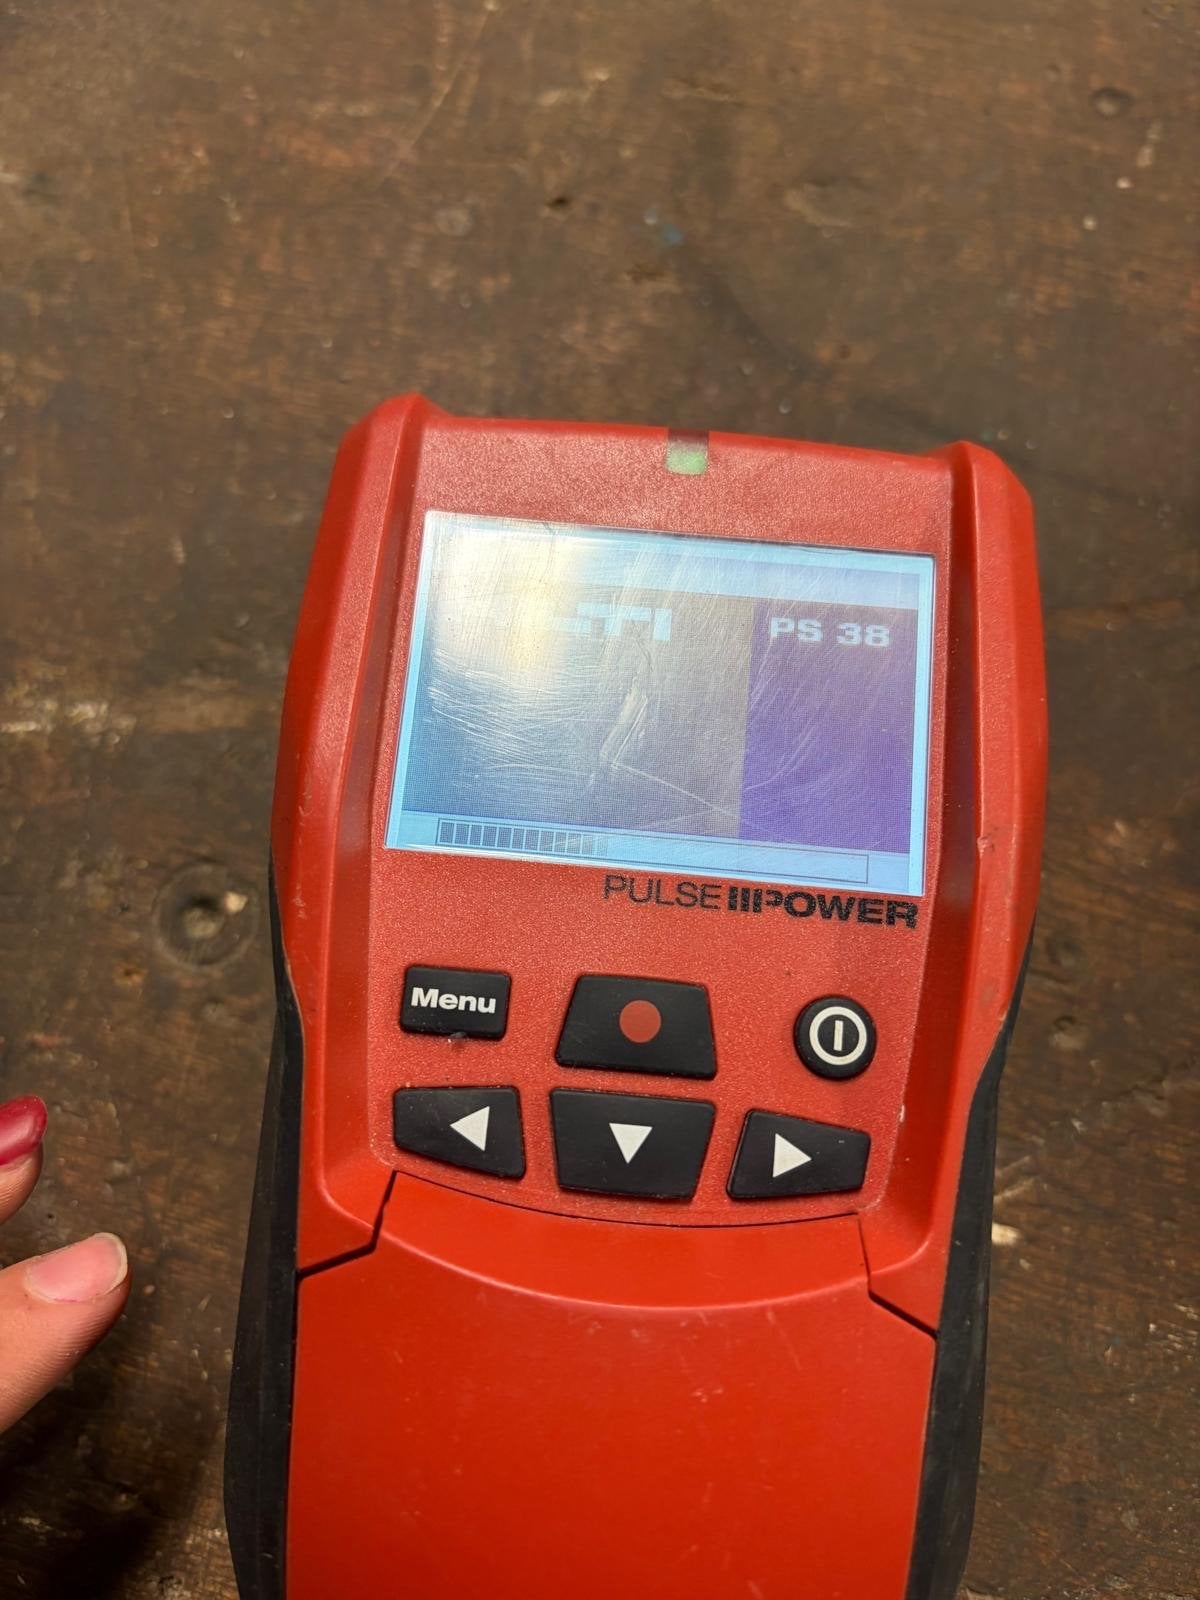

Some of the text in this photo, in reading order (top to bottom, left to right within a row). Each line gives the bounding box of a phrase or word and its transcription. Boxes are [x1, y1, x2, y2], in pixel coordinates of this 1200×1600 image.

[769, 616, 891, 647] PS 38
[603, 874, 722, 910] PULSE
[411, 986, 496, 1014] Menu
